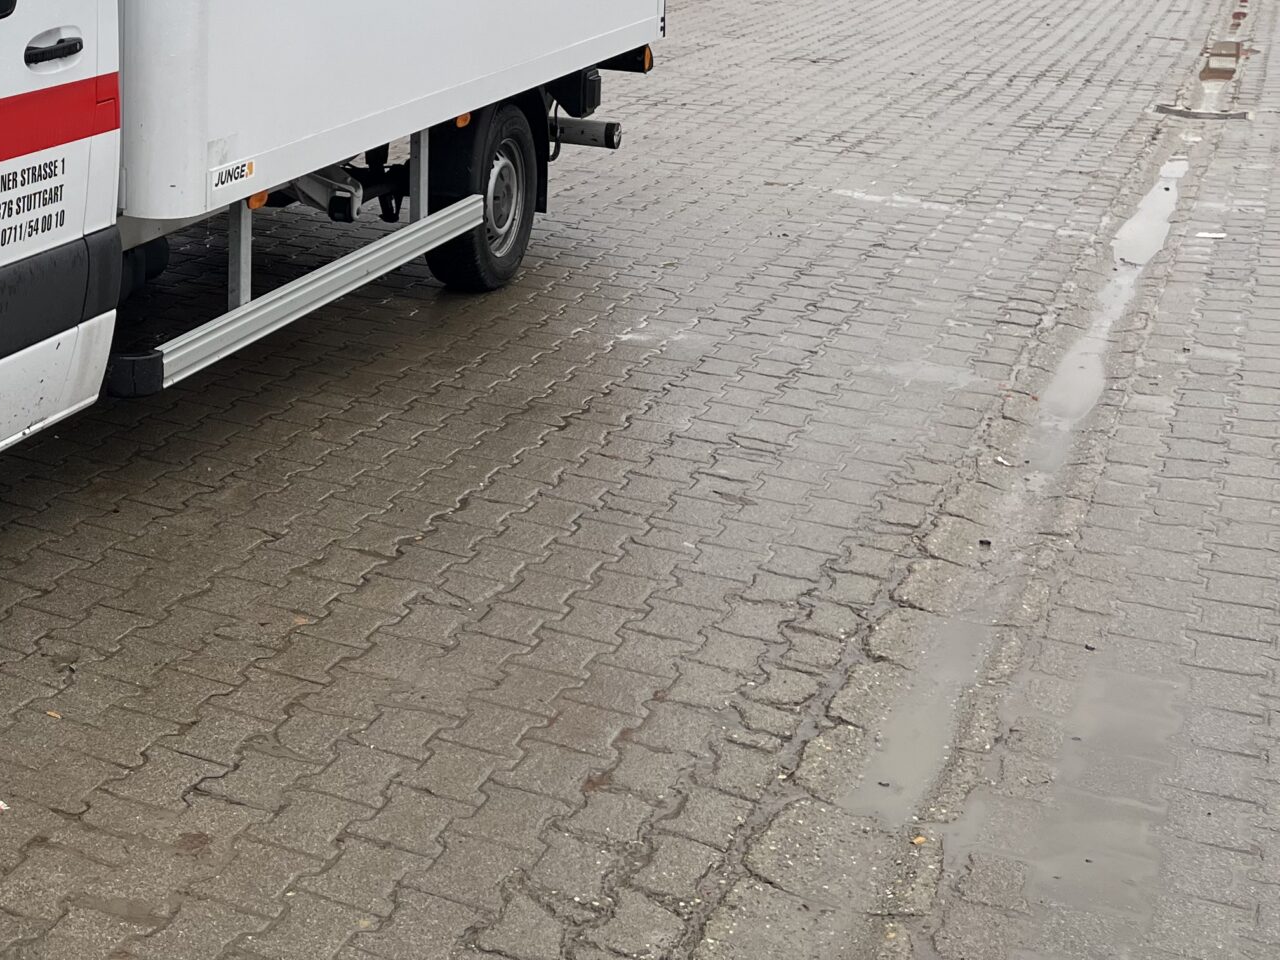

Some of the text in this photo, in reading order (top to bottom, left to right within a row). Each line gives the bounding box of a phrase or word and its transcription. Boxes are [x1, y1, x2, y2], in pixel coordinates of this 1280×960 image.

[20, 162, 58, 189] STRASSE
[61, 157, 65, 175] 1
[15, 184, 65, 215] STUTTGART
